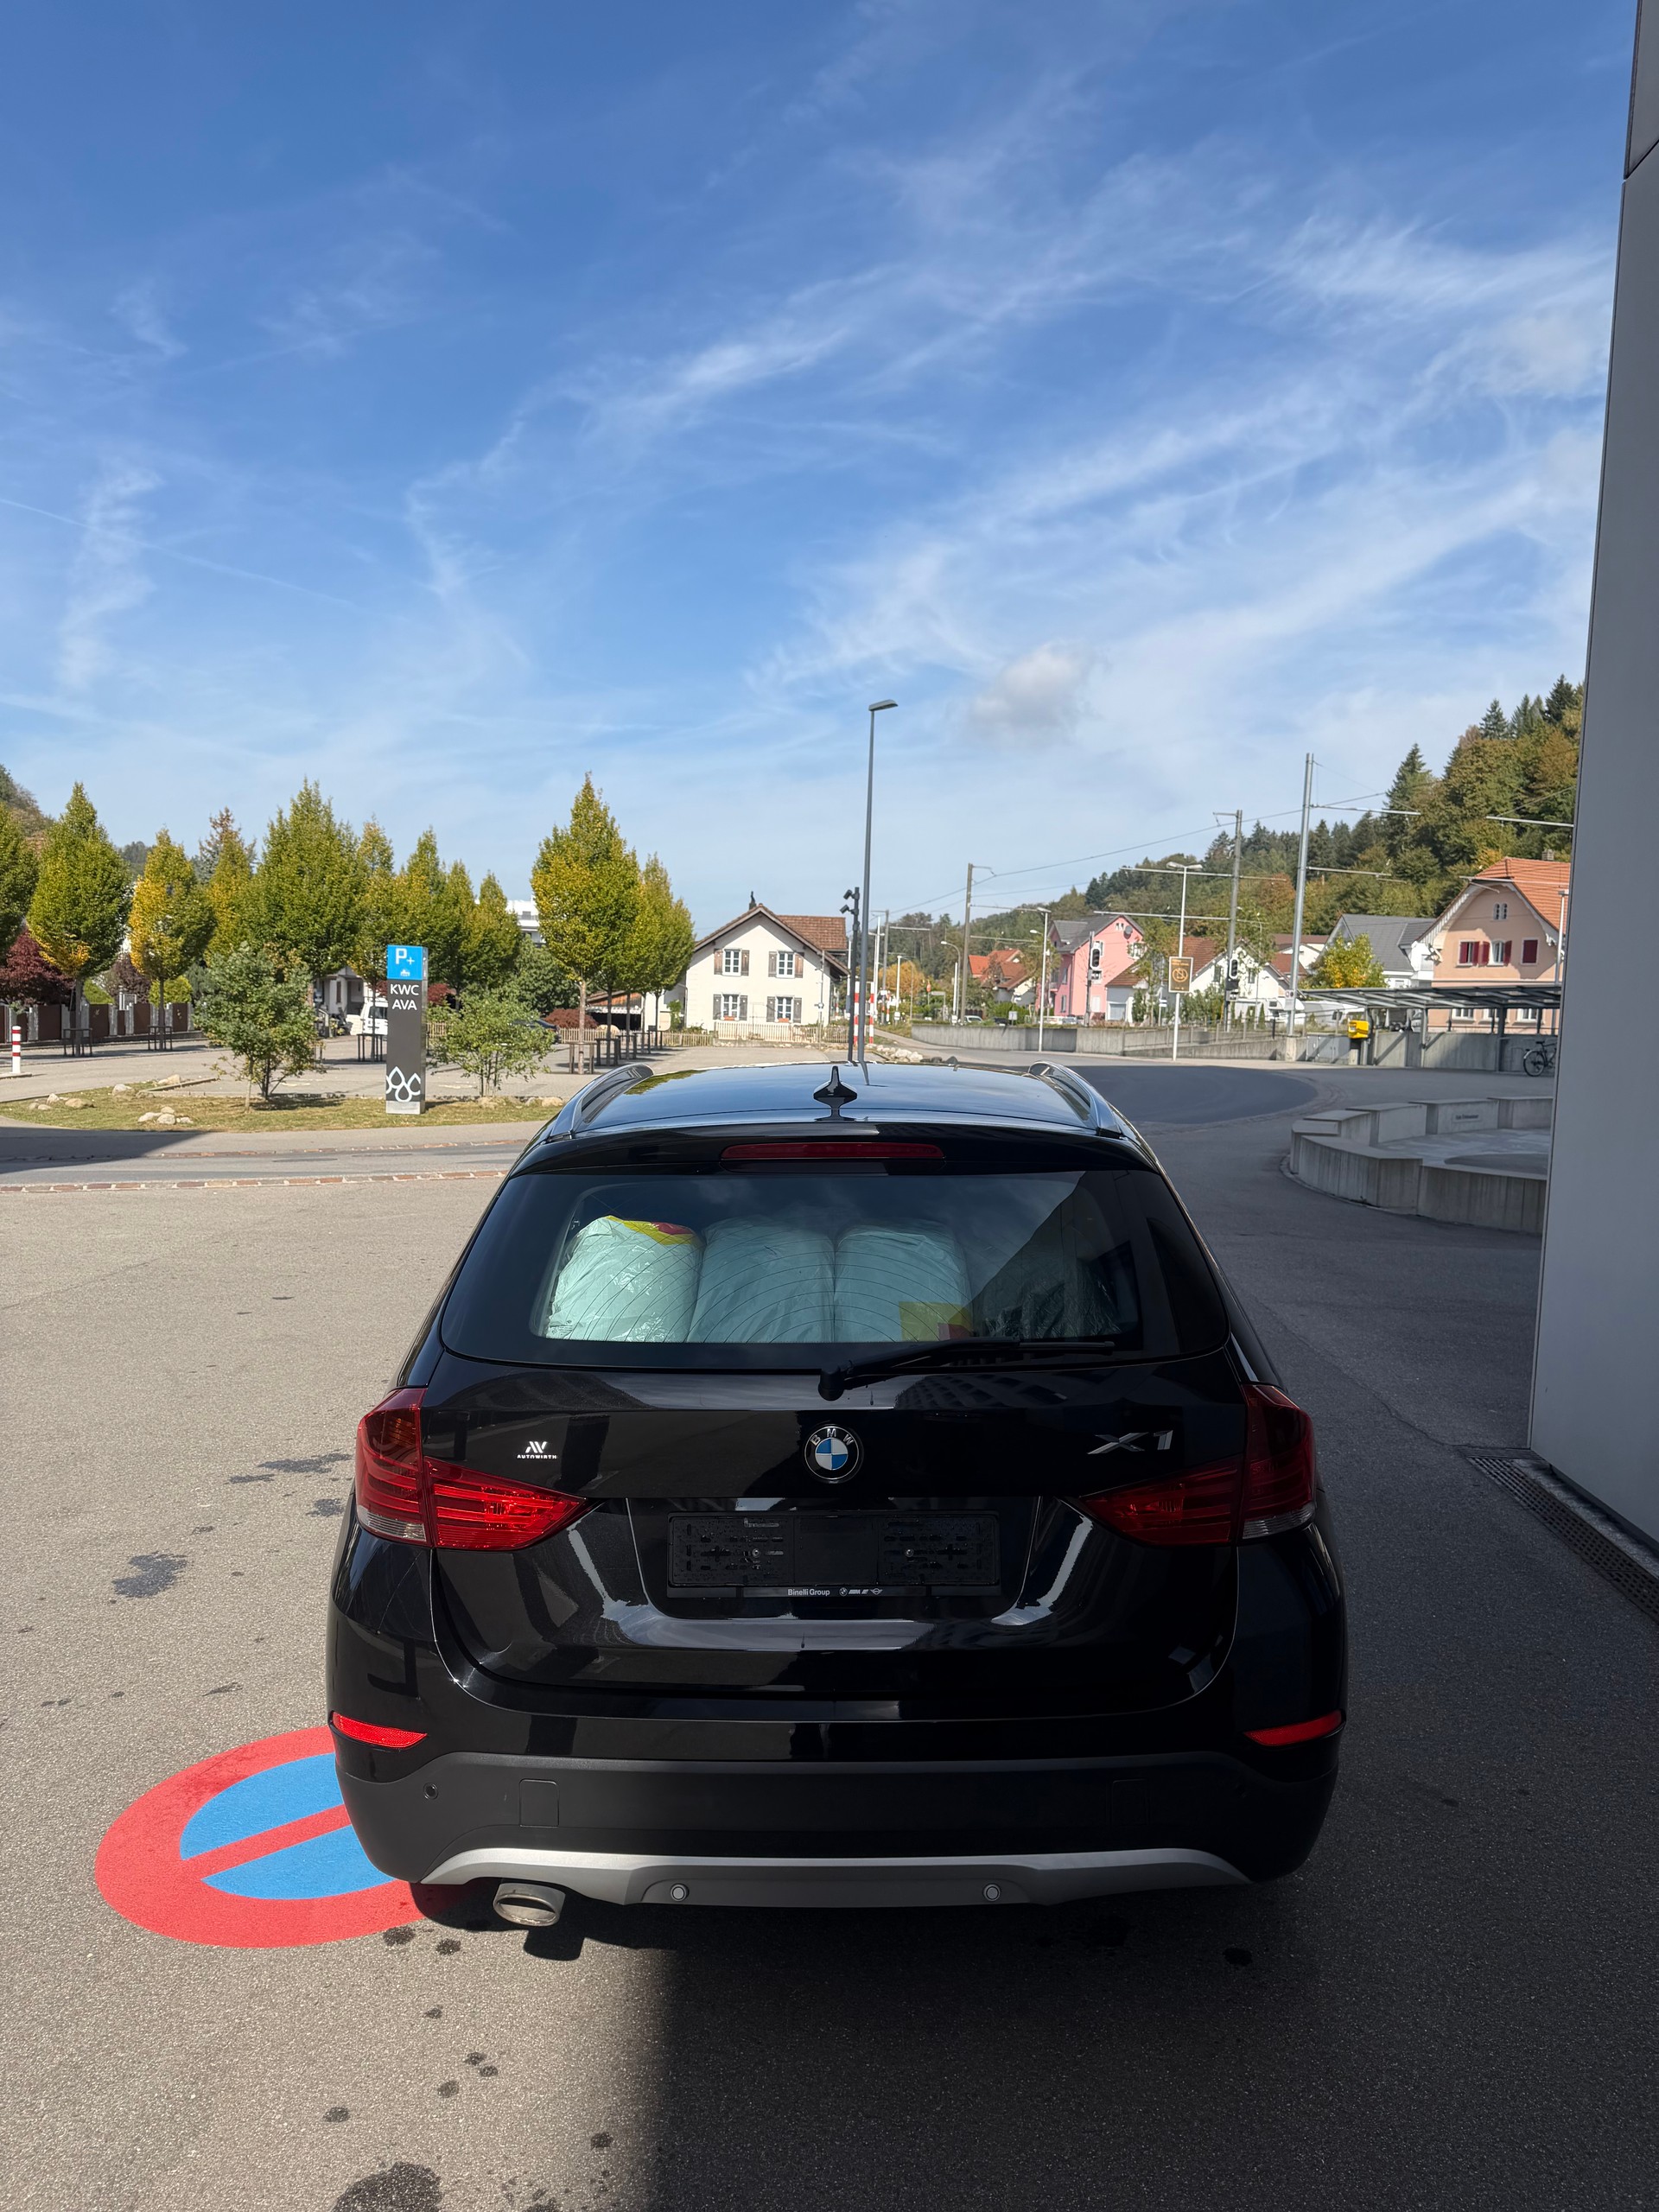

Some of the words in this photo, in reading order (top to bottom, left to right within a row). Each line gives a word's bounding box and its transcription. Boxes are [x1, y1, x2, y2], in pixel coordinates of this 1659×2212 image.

[390, 983, 419, 995] KWC
[391, 999, 417, 1010] AVA
[810, 1427, 854, 1446] BMW
[1087, 1430, 1173, 1454] X1
[809, 1588, 830, 1597] Group
